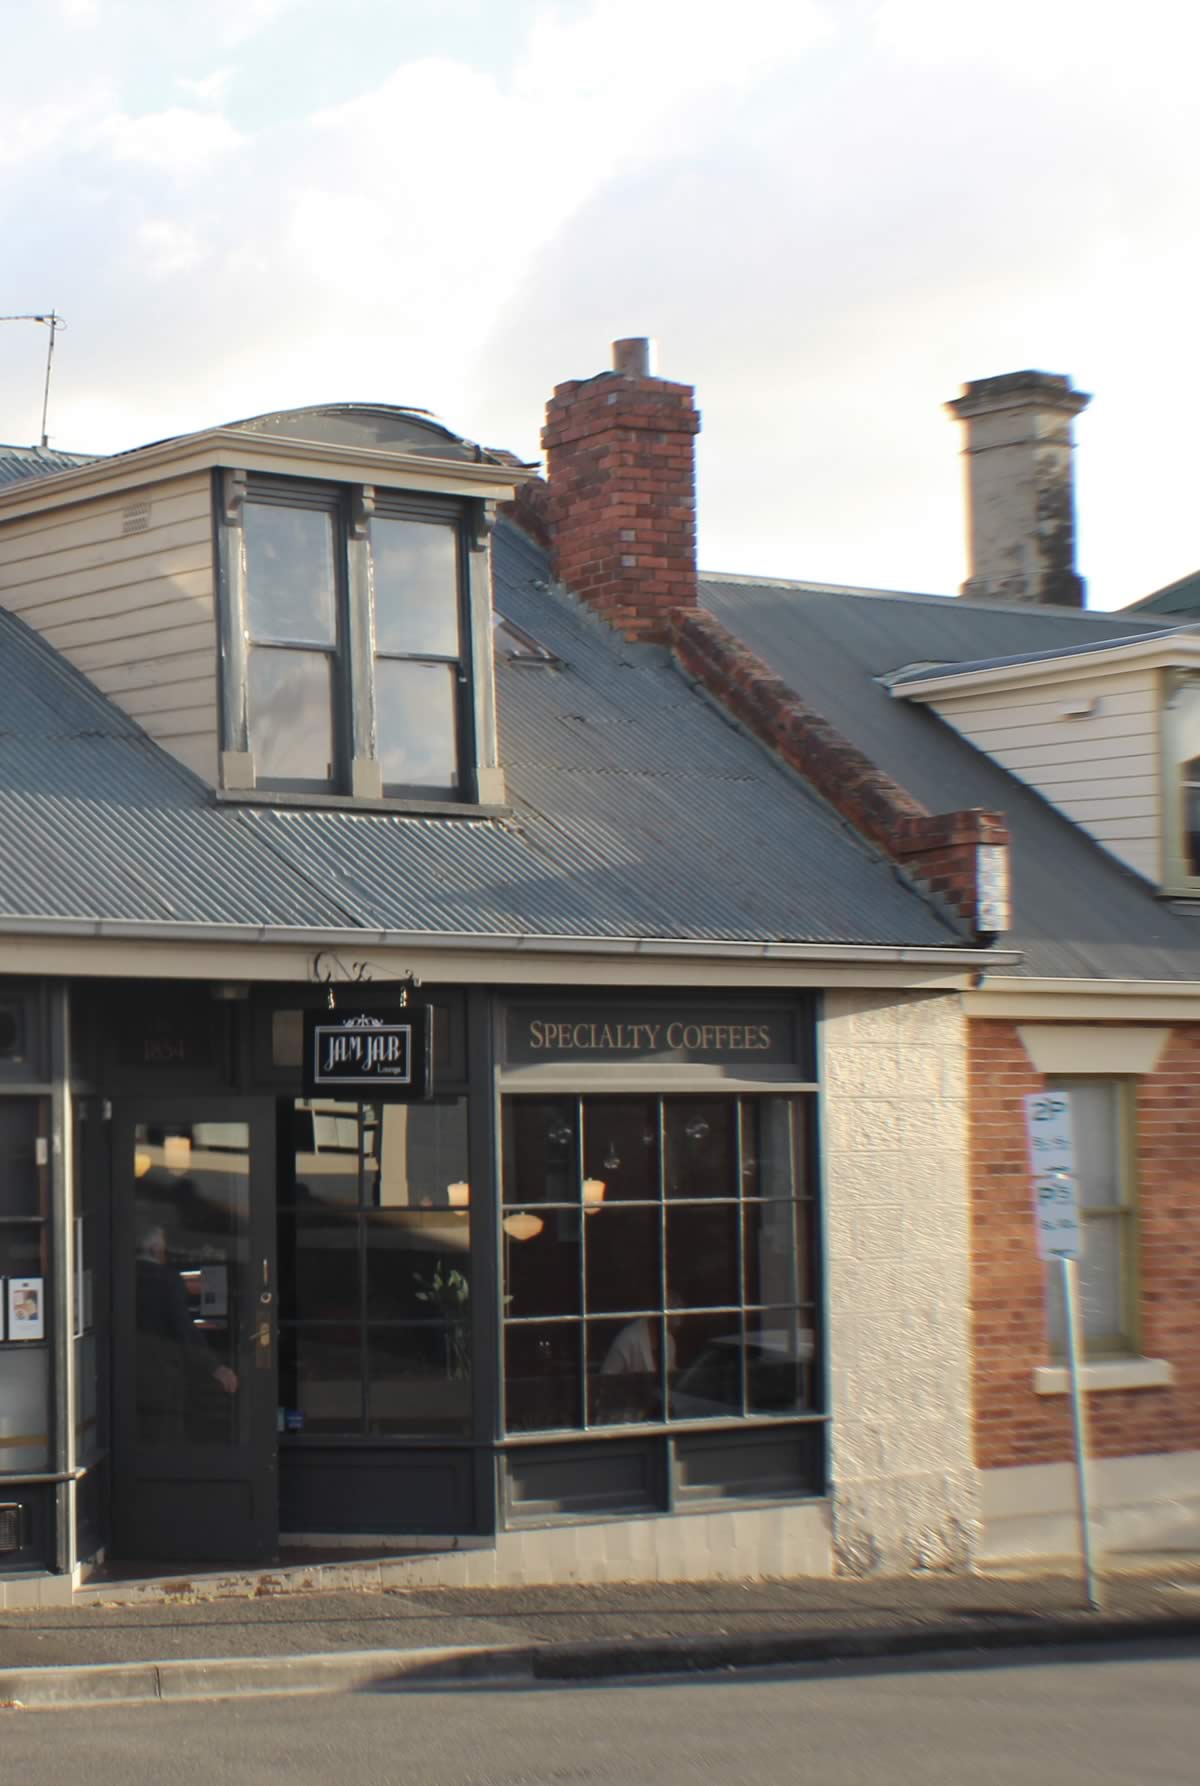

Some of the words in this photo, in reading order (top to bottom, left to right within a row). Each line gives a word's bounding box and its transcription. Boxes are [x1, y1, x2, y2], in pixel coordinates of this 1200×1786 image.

[529, 1020, 661, 1049] SPECIALTY
[666, 1022, 771, 1050] COFFEES
[323, 1035, 363, 1072] JAM
